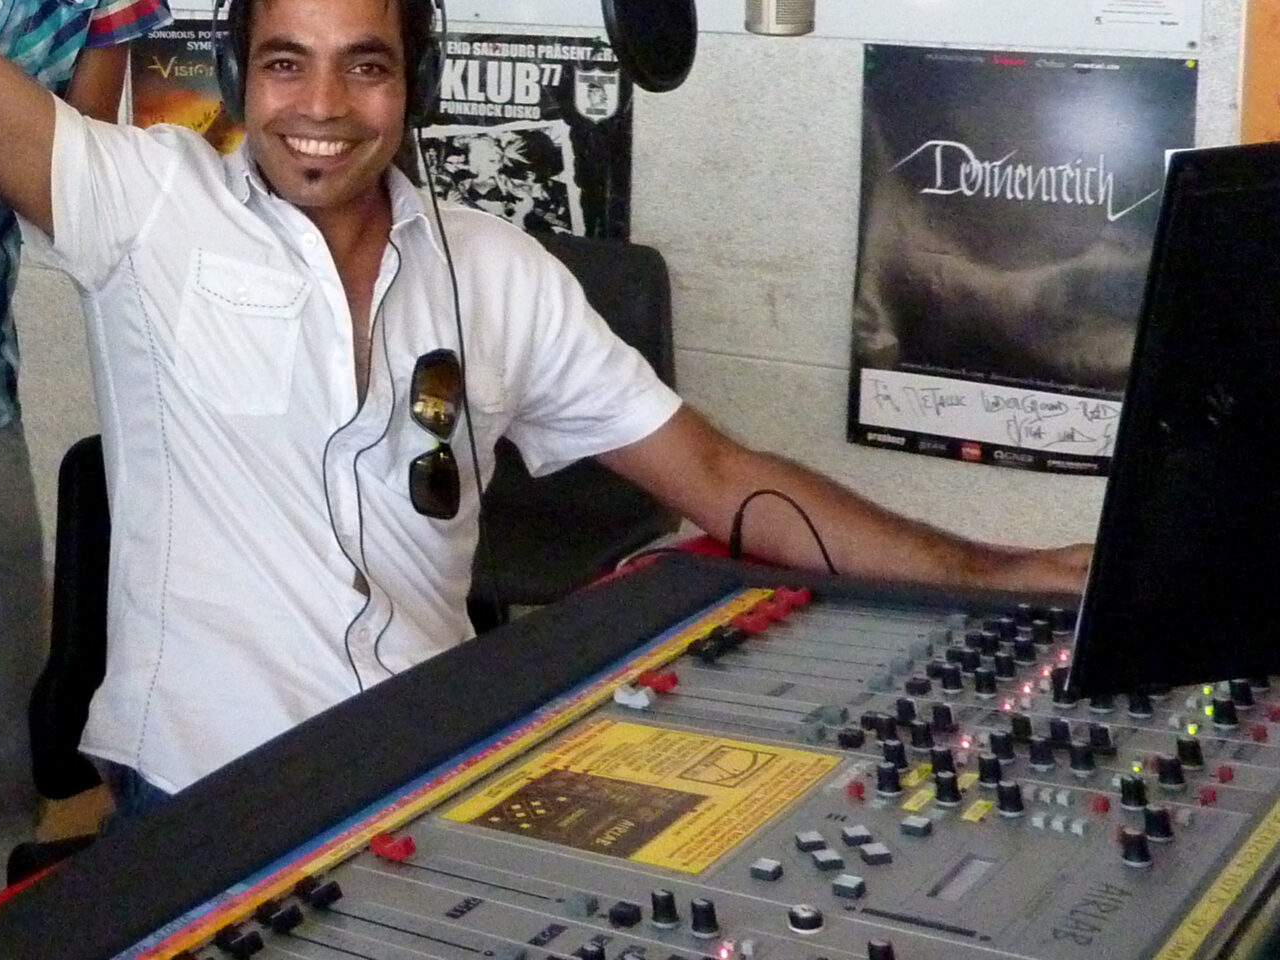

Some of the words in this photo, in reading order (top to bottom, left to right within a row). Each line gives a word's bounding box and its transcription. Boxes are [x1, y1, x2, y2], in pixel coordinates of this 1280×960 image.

[147, 30, 195, 40] SONOROUS
[472, 42, 535, 58] SALZBURG
[439, 100, 503, 118] PUNKROCK
[505, 104, 541, 120] DISKO
